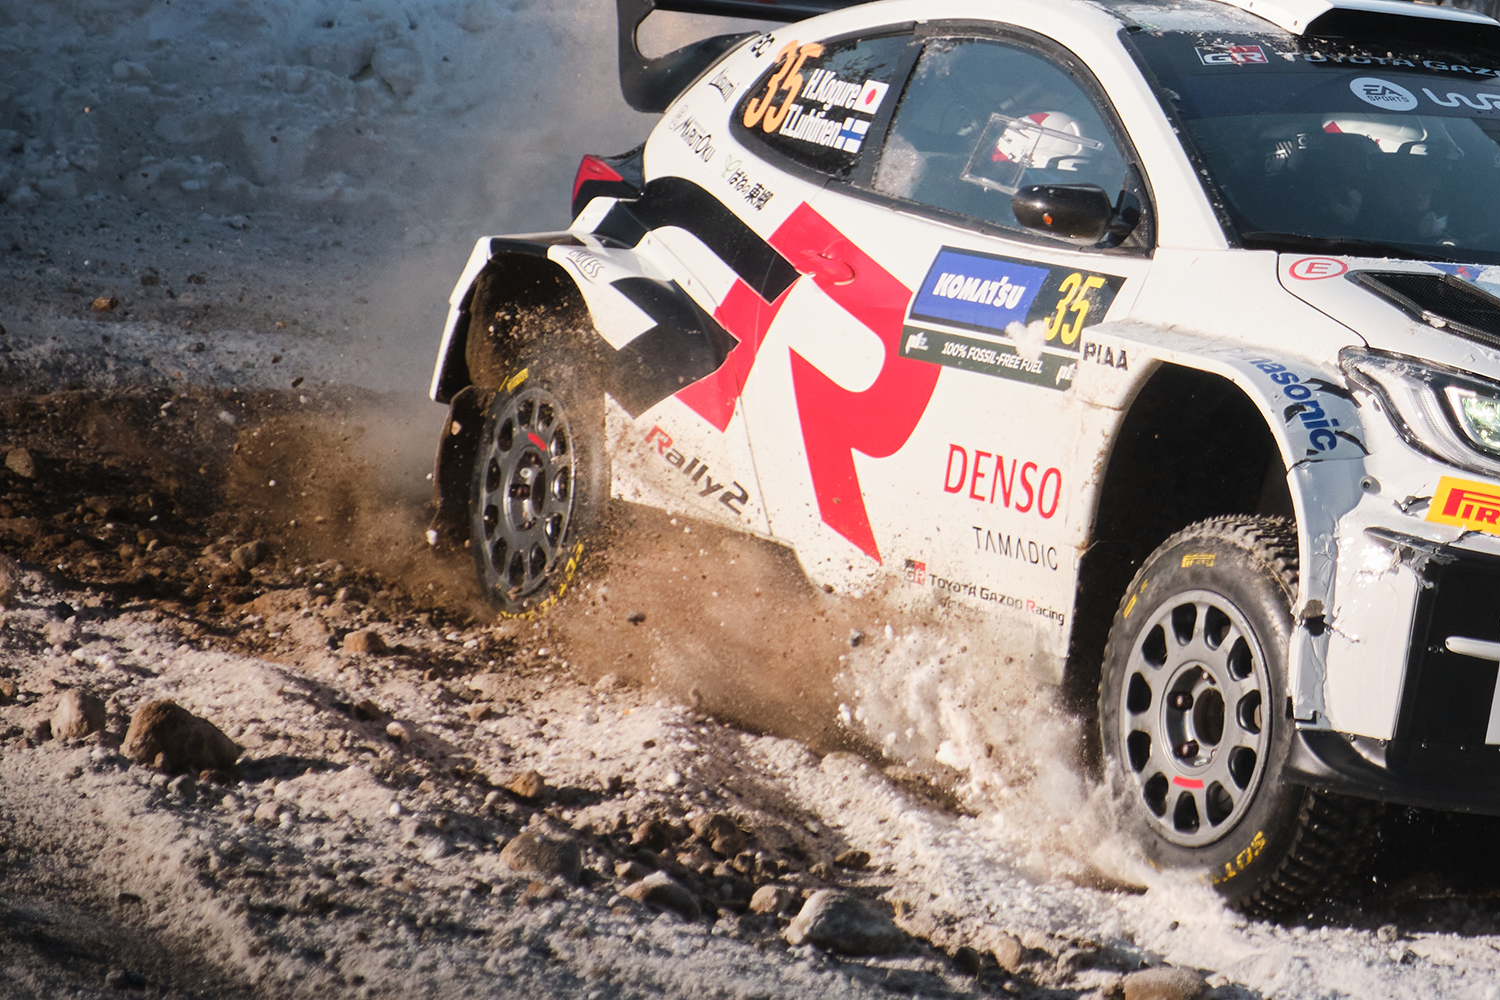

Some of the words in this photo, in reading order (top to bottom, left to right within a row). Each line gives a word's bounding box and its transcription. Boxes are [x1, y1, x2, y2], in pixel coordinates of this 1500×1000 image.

[1204, 52, 1264, 63] GR
[743, 39, 825, 133] 35
[801, 68, 863, 111] H.Kogure
[1362, 84, 1404, 96] EA
[1366, 95, 1410, 103] SPORTS
[932, 273, 1026, 310] KOMATSU
[1044, 272, 1106, 345] 35
[941, 341, 968, 359] 100%
[966, 346, 1022, 370] FOSSIL-FREE
[1020, 358, 1044, 374] FUEL
[1083, 341, 1129, 372] PIAA
[644, 424, 749, 516] Rally2
[943, 443, 1062, 519] DENSO
[972, 525, 1058, 571] TAMADIC
[1026, 600, 1065, 627] Racing
